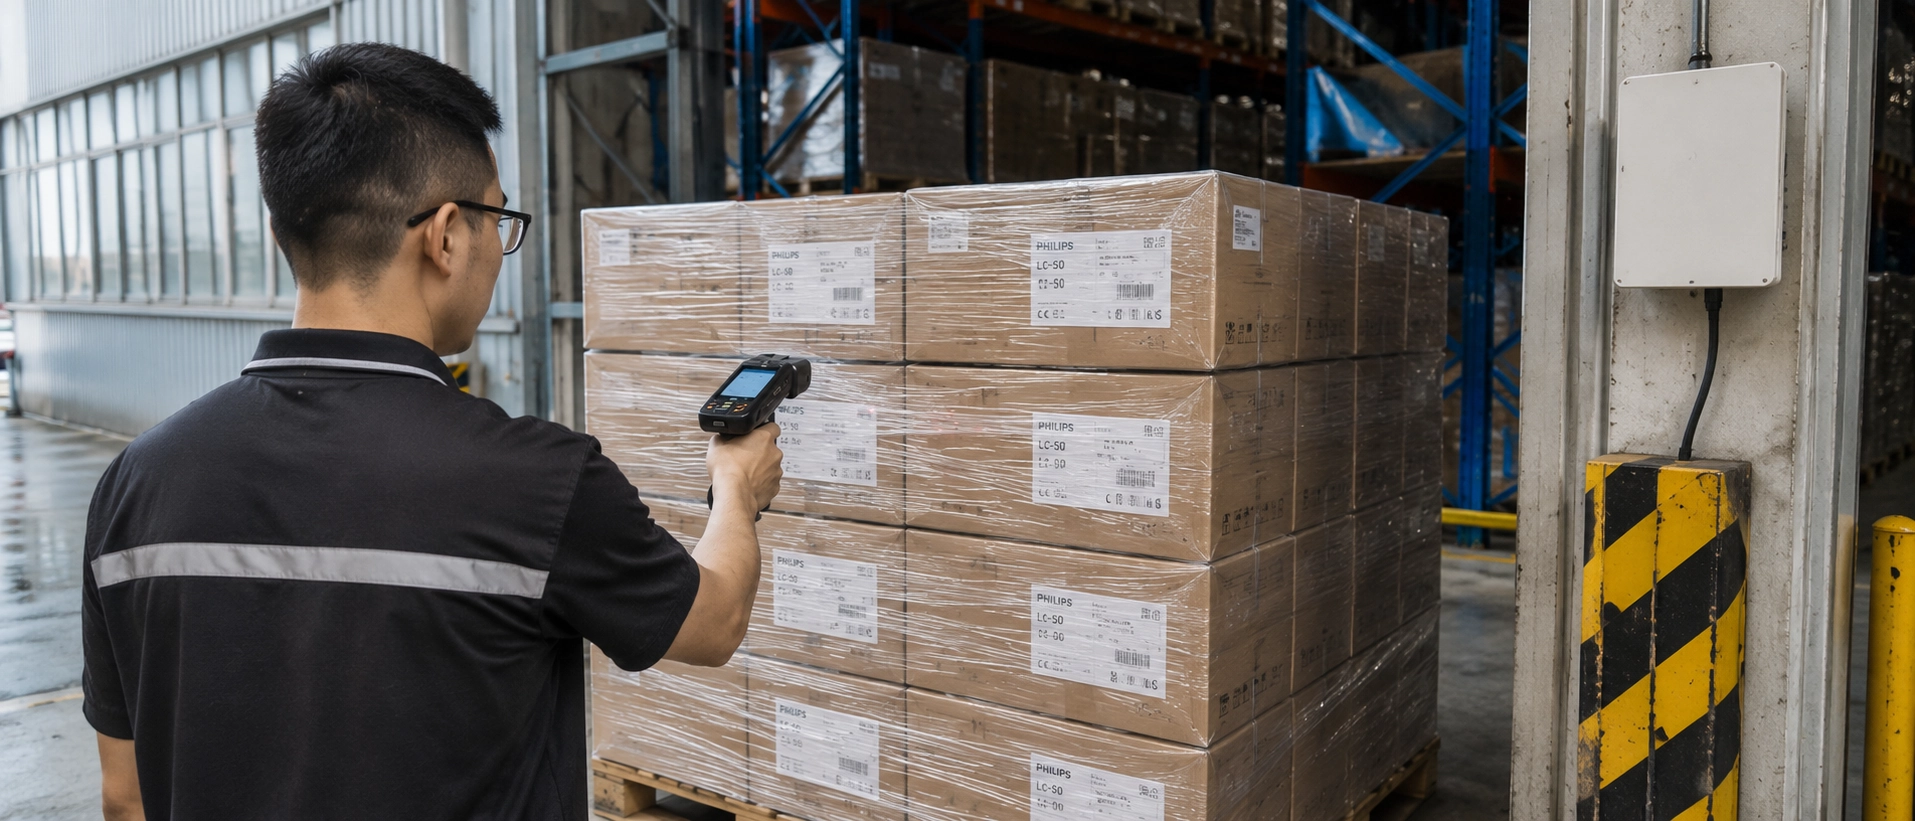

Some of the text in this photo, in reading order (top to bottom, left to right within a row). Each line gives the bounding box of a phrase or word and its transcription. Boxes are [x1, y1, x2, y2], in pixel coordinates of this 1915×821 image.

[1036, 241, 1074, 251] PHILIPS
[1038, 422, 1074, 432] PHILIPS
[1037, 593, 1073, 607] PHILIPS
[1036, 763, 1072, 779] PHILIPS
